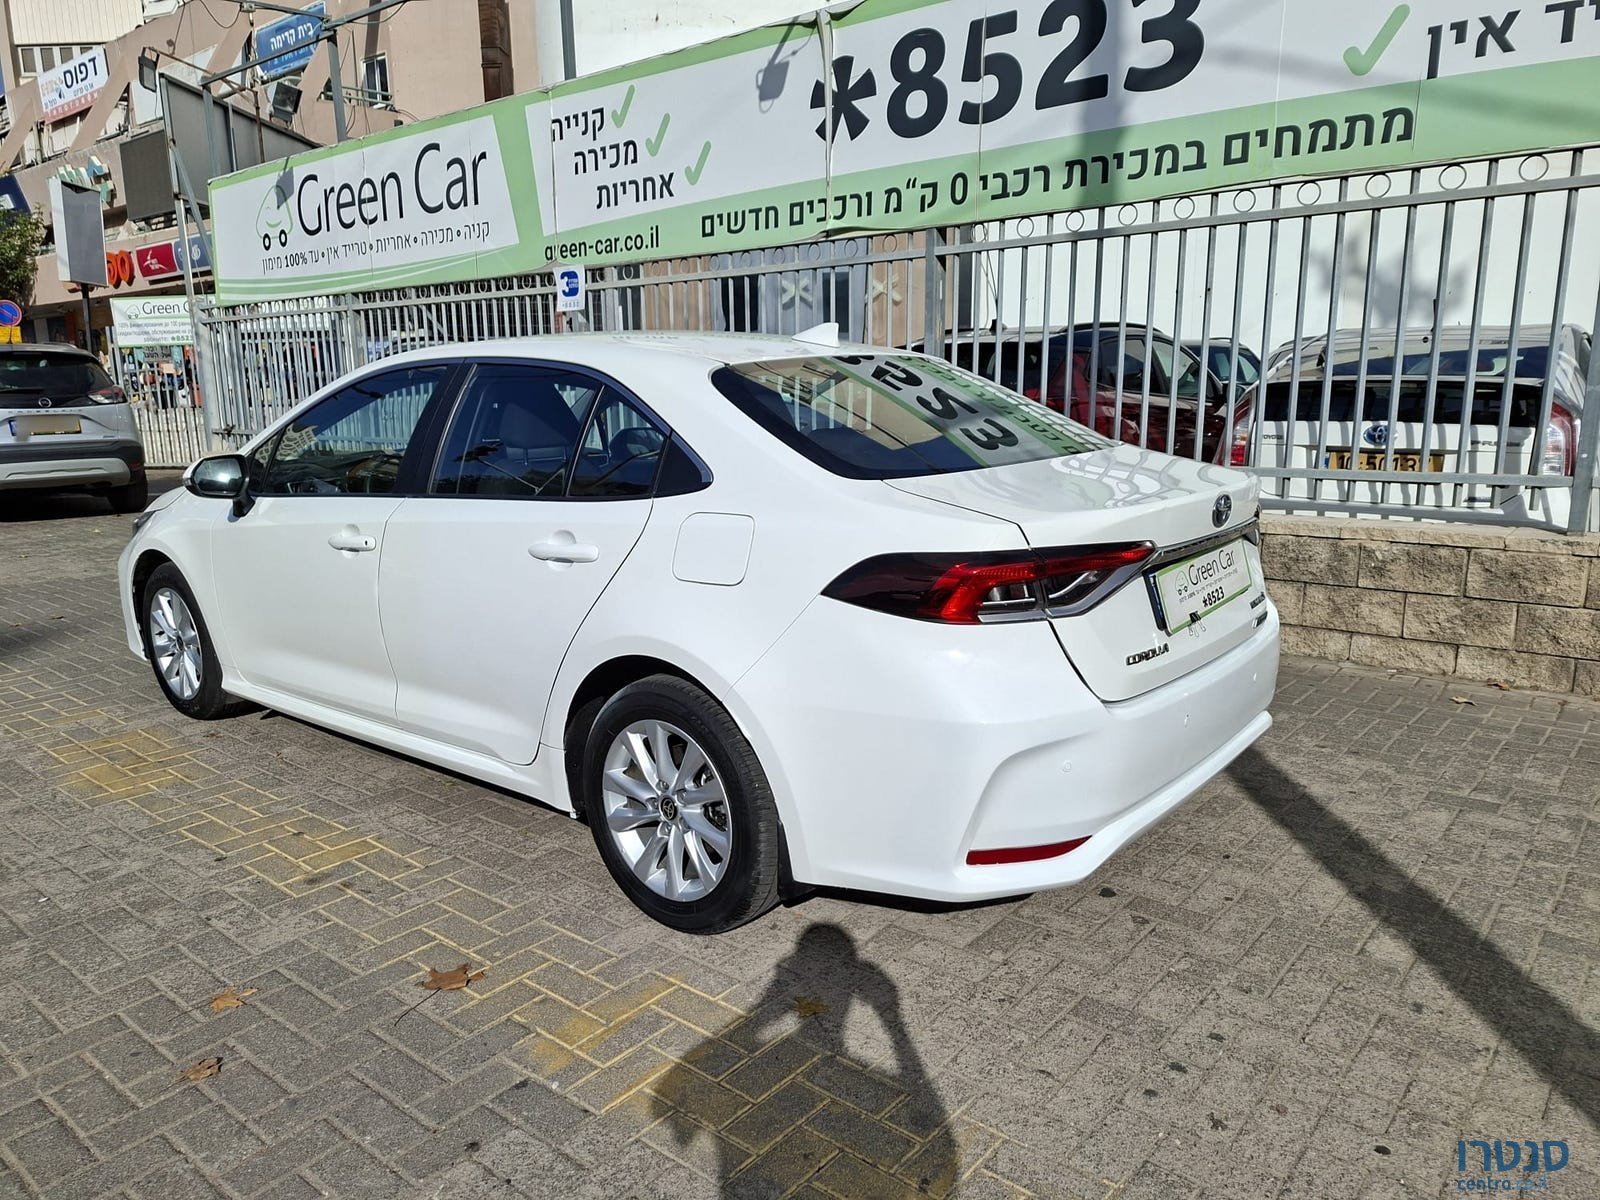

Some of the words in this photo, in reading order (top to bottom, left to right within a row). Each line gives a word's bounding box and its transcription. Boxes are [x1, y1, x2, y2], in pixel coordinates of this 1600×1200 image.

[1426, 9, 1521, 80] אין
[63, 56, 98, 89] דפוס
[551, 107, 605, 142] קנייה
[1223, 107, 1414, 167] מתמחים
[574, 139, 638, 175] מכירה
[1062, 139, 1207, 190] במכירת
[297, 171, 404, 236] Green
[414, 142, 487, 214] Car
[596, 172, 675, 210] אחריות
[950, 171, 969, 205] 0
[978, 164, 1050, 201] רכבי
[701, 205, 779, 238] חדשים
[790, 191, 872, 226] ורכבים
[376, 234, 411, 253] אחריות
[421, 227, 453, 246] מכירה
[464, 221, 489, 242] קניה
[545, 225, 659, 261] green-car.co.il
[262, 256, 282, 275] מימון
[285, 251, 308, 267] 100%
[309, 249, 320, 263] עד
[327, 245, 340, 265] אין
[342, 241, 367, 258] טרייד
[142, 301, 180, 315] Green
[1188, 559, 1220, 586] Green
[1219, 549, 1235, 570] Car
[1126, 642, 1170, 666] COROLLA
